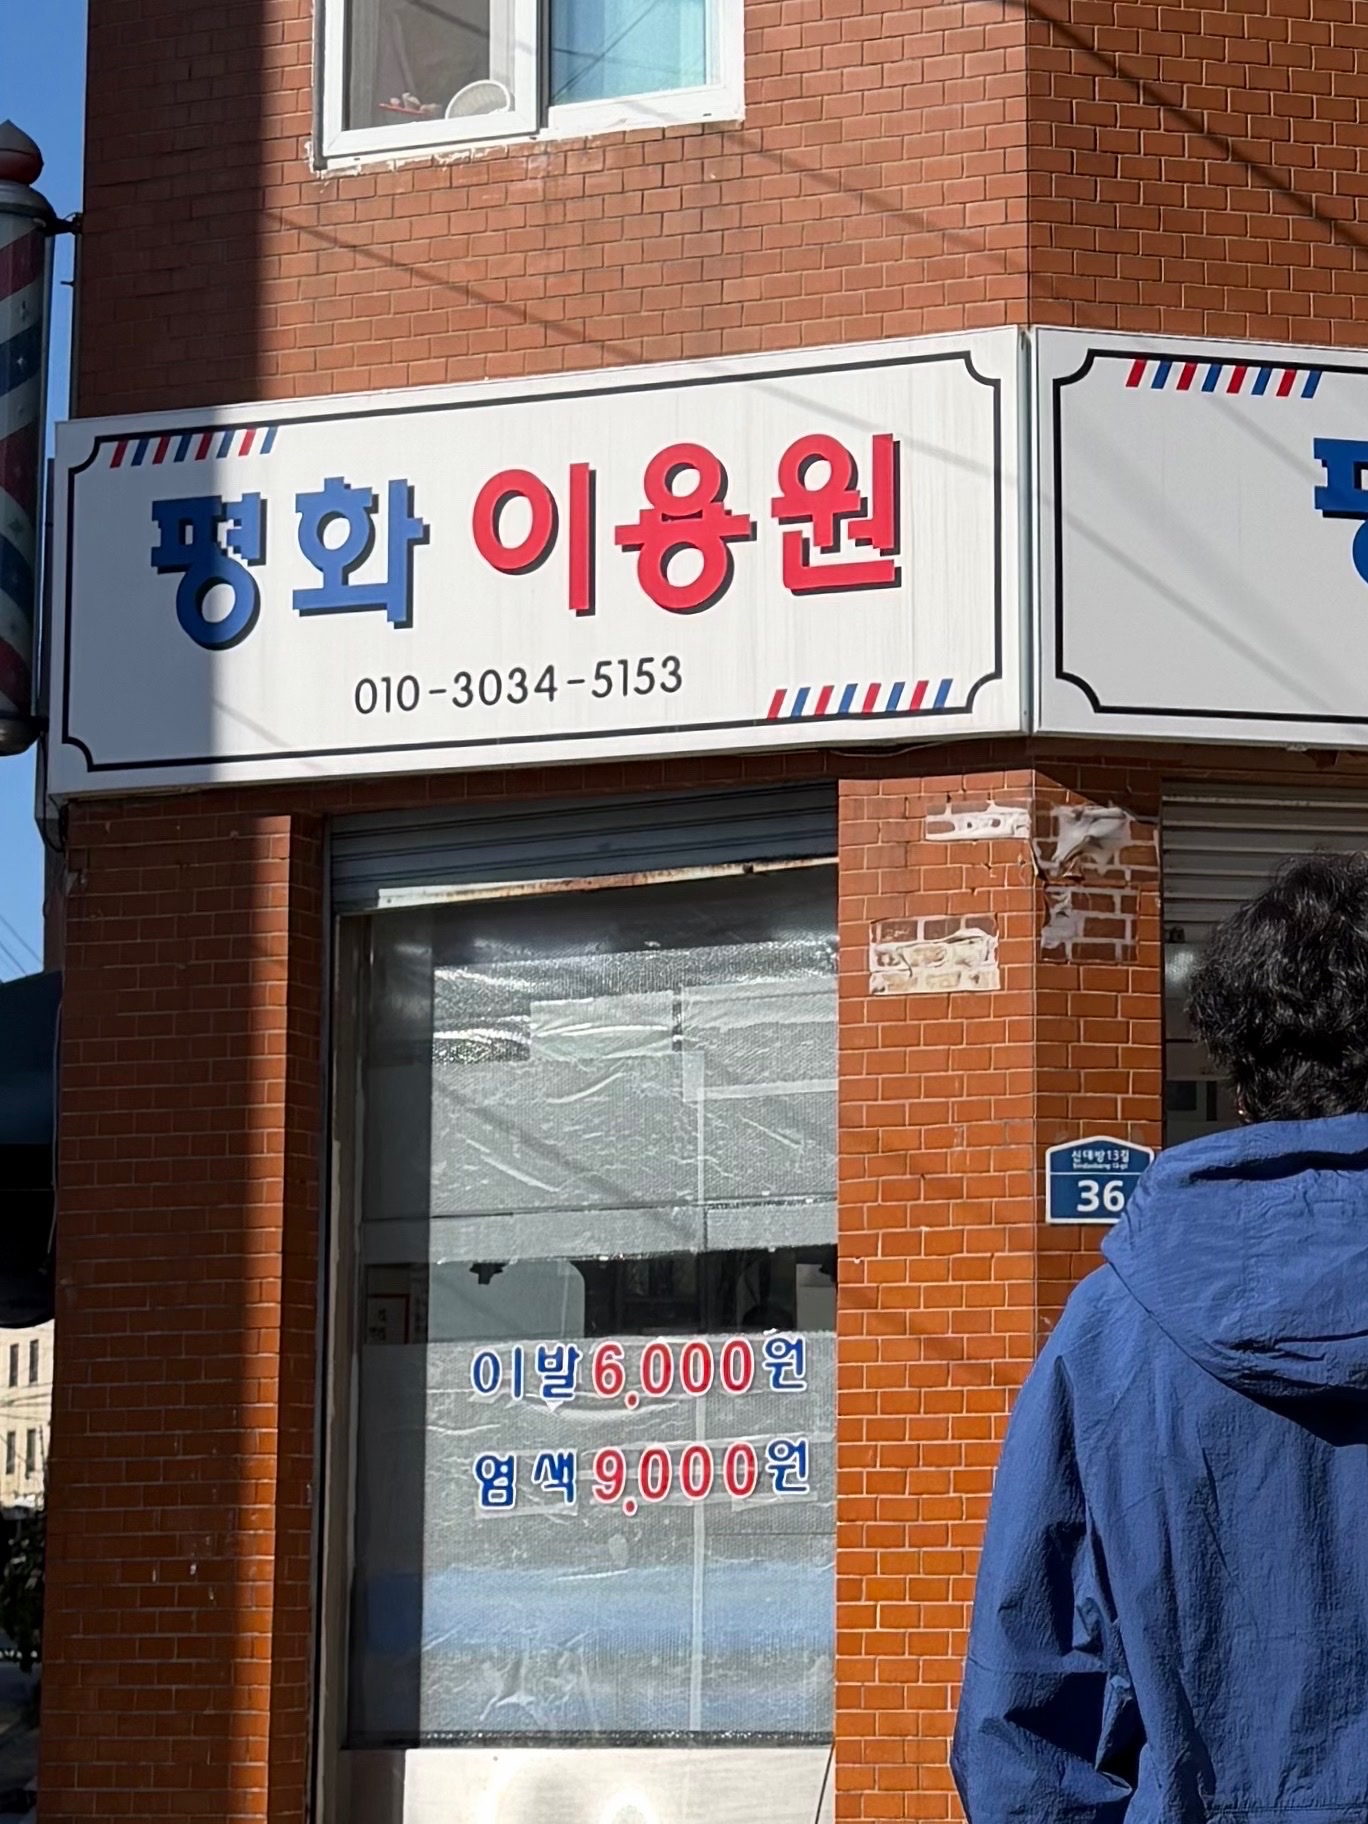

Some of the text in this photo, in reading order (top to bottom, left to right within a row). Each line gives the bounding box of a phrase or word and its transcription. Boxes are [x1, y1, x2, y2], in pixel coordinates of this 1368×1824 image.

[151, 432, 902, 651] 평화 이용원
[354, 654, 684, 715] 010-3034-5153
[1076, 1179, 1125, 1212] 36
[470, 1343, 582, 1402] 이발
[472, 1450, 579, 1511] 염색
